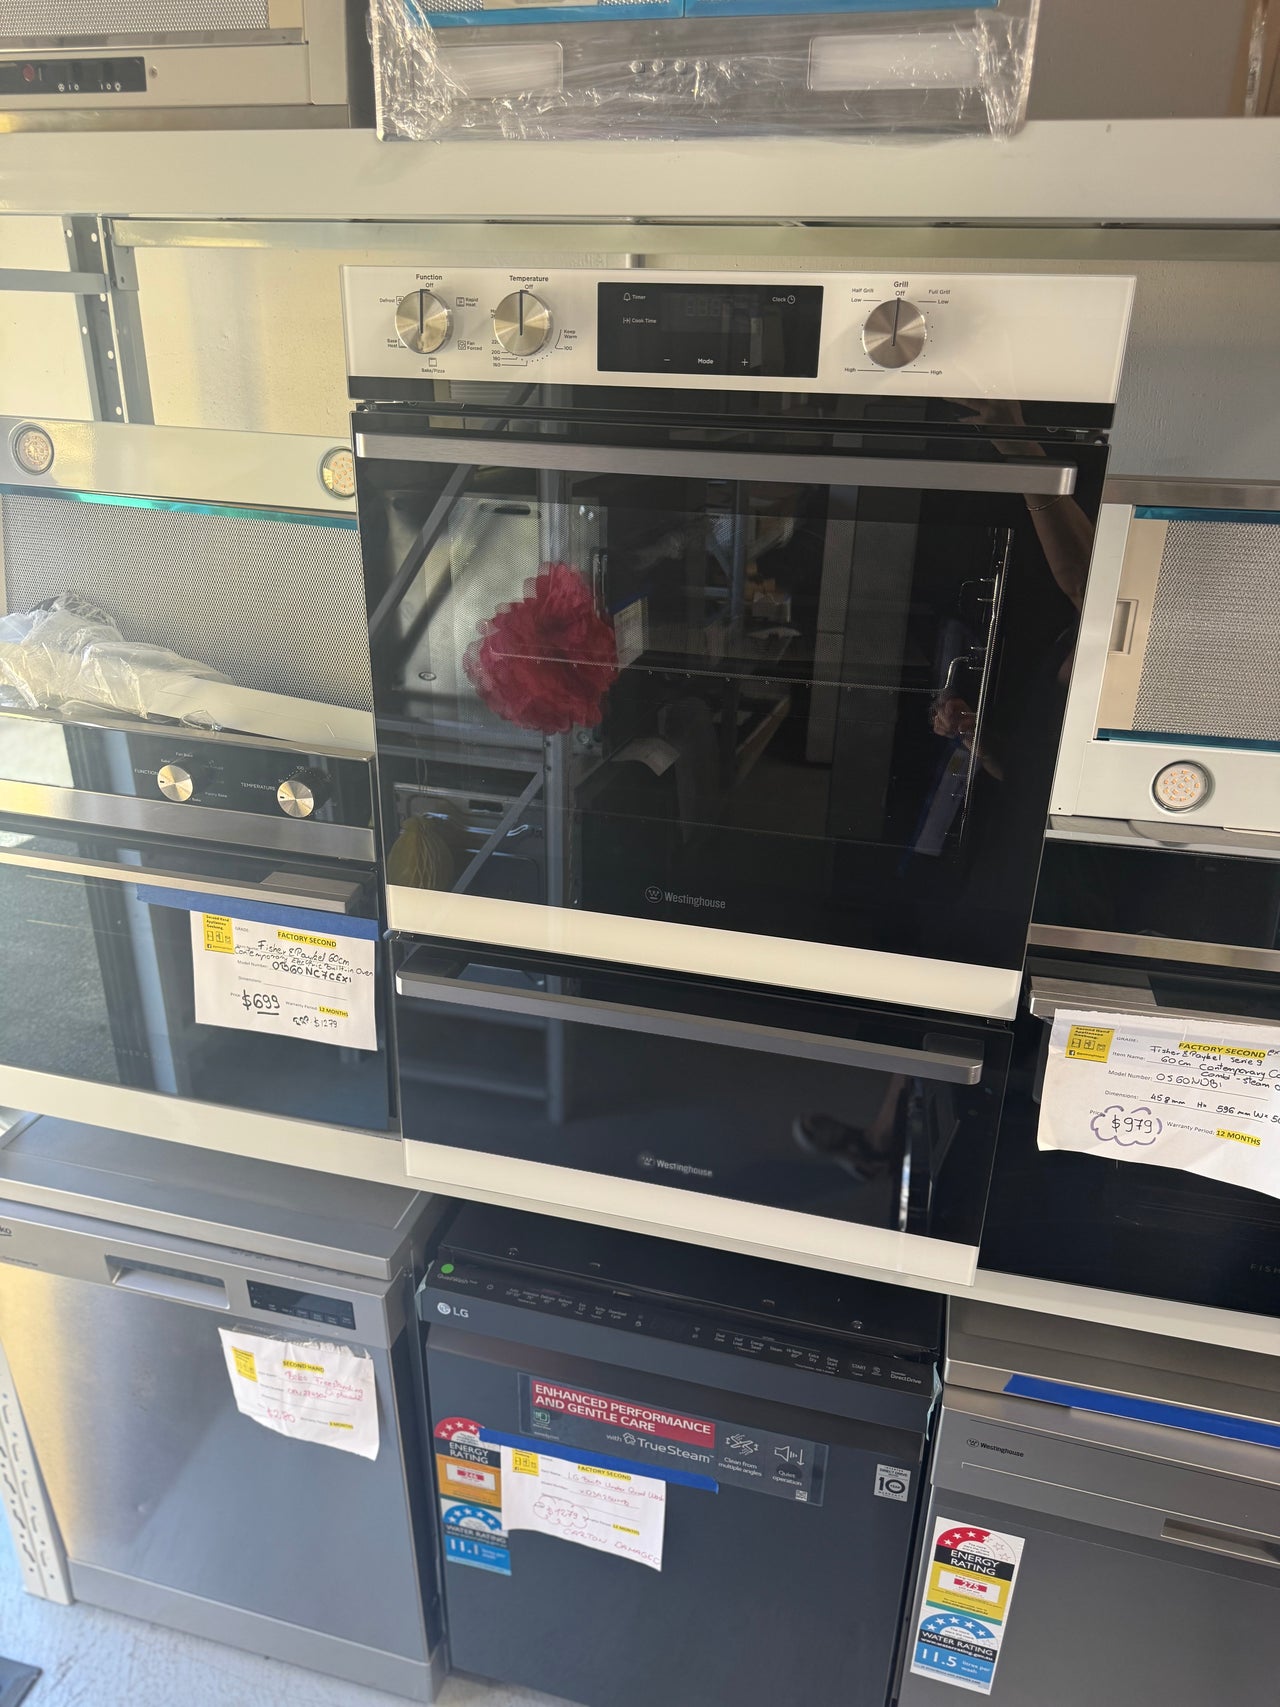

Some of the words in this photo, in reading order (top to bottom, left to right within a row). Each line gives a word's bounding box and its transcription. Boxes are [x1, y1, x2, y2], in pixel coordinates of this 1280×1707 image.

[241, 782, 276, 791] TEMPERATURE
[664, 891, 726, 909] Westinghouse
[278, 932, 308, 942] FACTORY
[309, 938, 337, 947] SECOND
[242, 988, 280, 1010] $699
[326, 1008, 349, 1017] MONTHS
[1178, 1042, 1224, 1053] FACTORY
[1225, 1048, 1266, 1059] SECOND
[1108, 1070, 1127, 1078] Model
[1199, 1063, 1266, 1081] Contemporary
[1105, 1090, 1139, 1100] Dimensions:
[1112, 1114, 1152, 1133] $979
[1166, 1122, 1193, 1131] Warranty
[1226, 1132, 1261, 1146] MONTHS
[657, 1159, 713, 1177] Westinghouse
[453, 1306, 469, 1318] LG
[283, 1360, 307, 1369] SECOND
[307, 1364, 324, 1373] HAND
[535, 1384, 608, 1409] ENHANCED
[610, 1402, 711, 1435] PERFORMANCE
[535, 1395, 565, 1409] AND
[567, 1403, 618, 1423] GENTLE
[621, 1416, 656, 1432] CARE
[606, 1434, 622, 1442] with
[449, 1442, 488, 1456] ENERGY
[450, 1449, 488, 1464] RATING
[981, 1442, 1024, 1458] Westinghouse
[718, 1462, 742, 1471] multiple
[743, 1468, 762, 1477] angles
[724, 1456, 741, 1465] Clean
[742, 1460, 758, 1469] from
[577, 1464, 606, 1475] FACTORY
[606, 1470, 632, 1481] SECOND
[772, 1476, 802, 1486] operation
[778, 1470, 796, 1478] Quiet
[878, 1476, 906, 1494] 10
[446, 1524, 474, 1535] WATER
[475, 1531, 506, 1544] RATING
[563, 1528, 607, 1544] CARTON
[451, 1538, 479, 1555] 11.1
[950, 1550, 1000, 1568] ENERGY
[950, 1558, 996, 1576] RATING
[921, 1631, 954, 1645] WATER
[957, 1640, 993, 1656] RATING
[922, 1648, 958, 1667] 11.5
